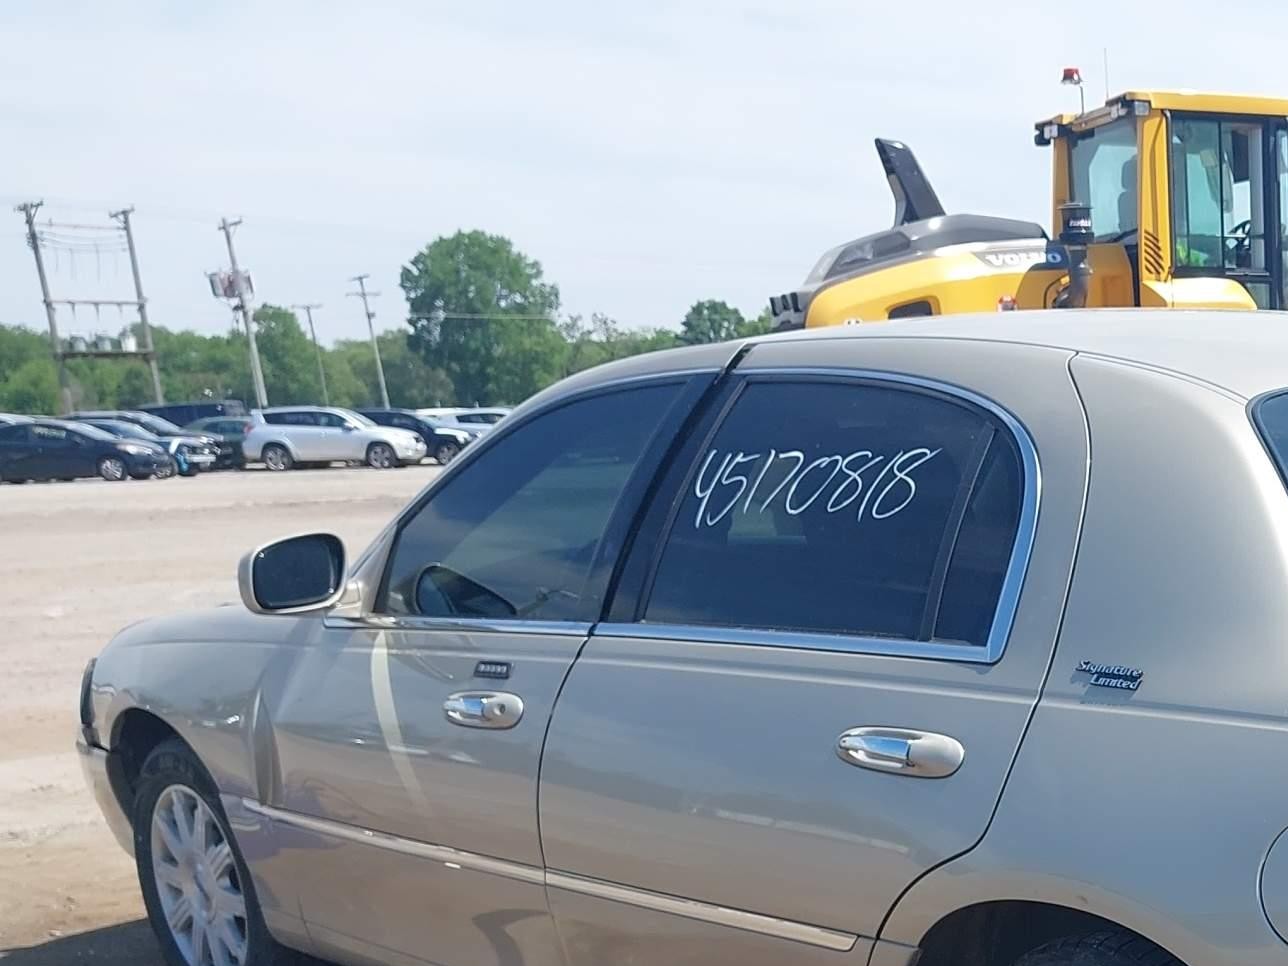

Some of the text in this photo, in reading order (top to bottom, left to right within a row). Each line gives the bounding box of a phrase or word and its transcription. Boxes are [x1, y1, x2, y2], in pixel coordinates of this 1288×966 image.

[985, 251, 1062, 266] VOLVO
[694, 447, 943, 529] 45170818
[1075, 659, 1144, 679] Signature
[1089, 674, 1144, 691] Limited
